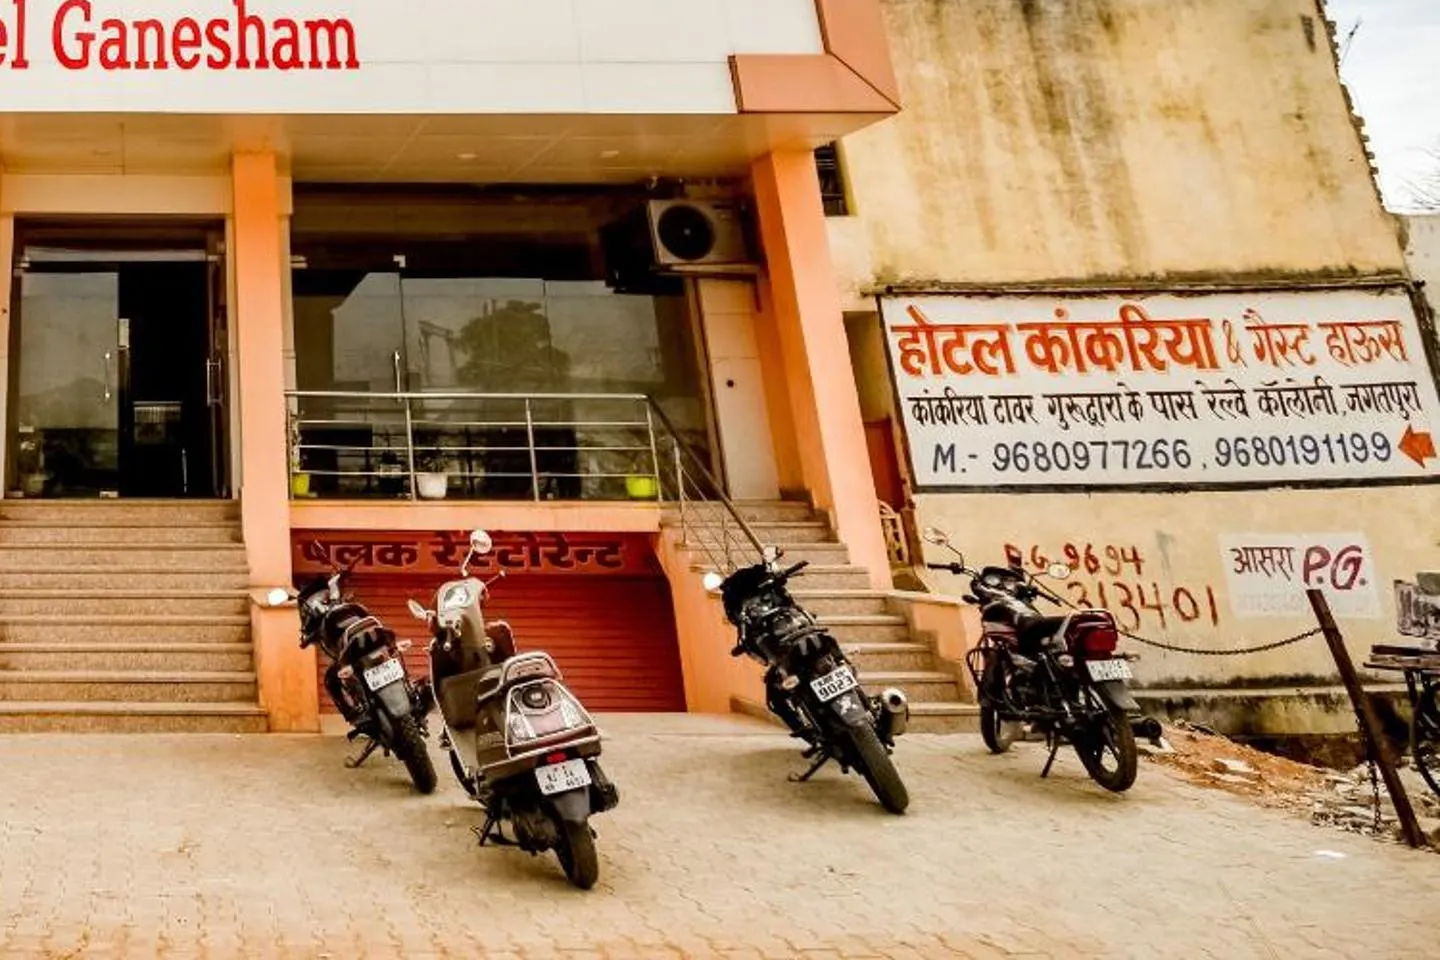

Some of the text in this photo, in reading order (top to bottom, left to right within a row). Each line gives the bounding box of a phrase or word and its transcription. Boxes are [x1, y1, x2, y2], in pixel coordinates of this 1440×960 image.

[891, 305, 1016, 376] होटल
[1017, 304, 1219, 374] कांकरिया
[908, 386, 988, 427] कांकरिया
[988, 394, 1038, 425] टावर
[1117, 382, 1144, 424] के
[1147, 390, 1198, 421] पास
[1215, 431, 1392, 468] 9680191199
[1063, 543, 1145, 576] 9694
[1229, 544, 1367, 590] आसरा P.G.
